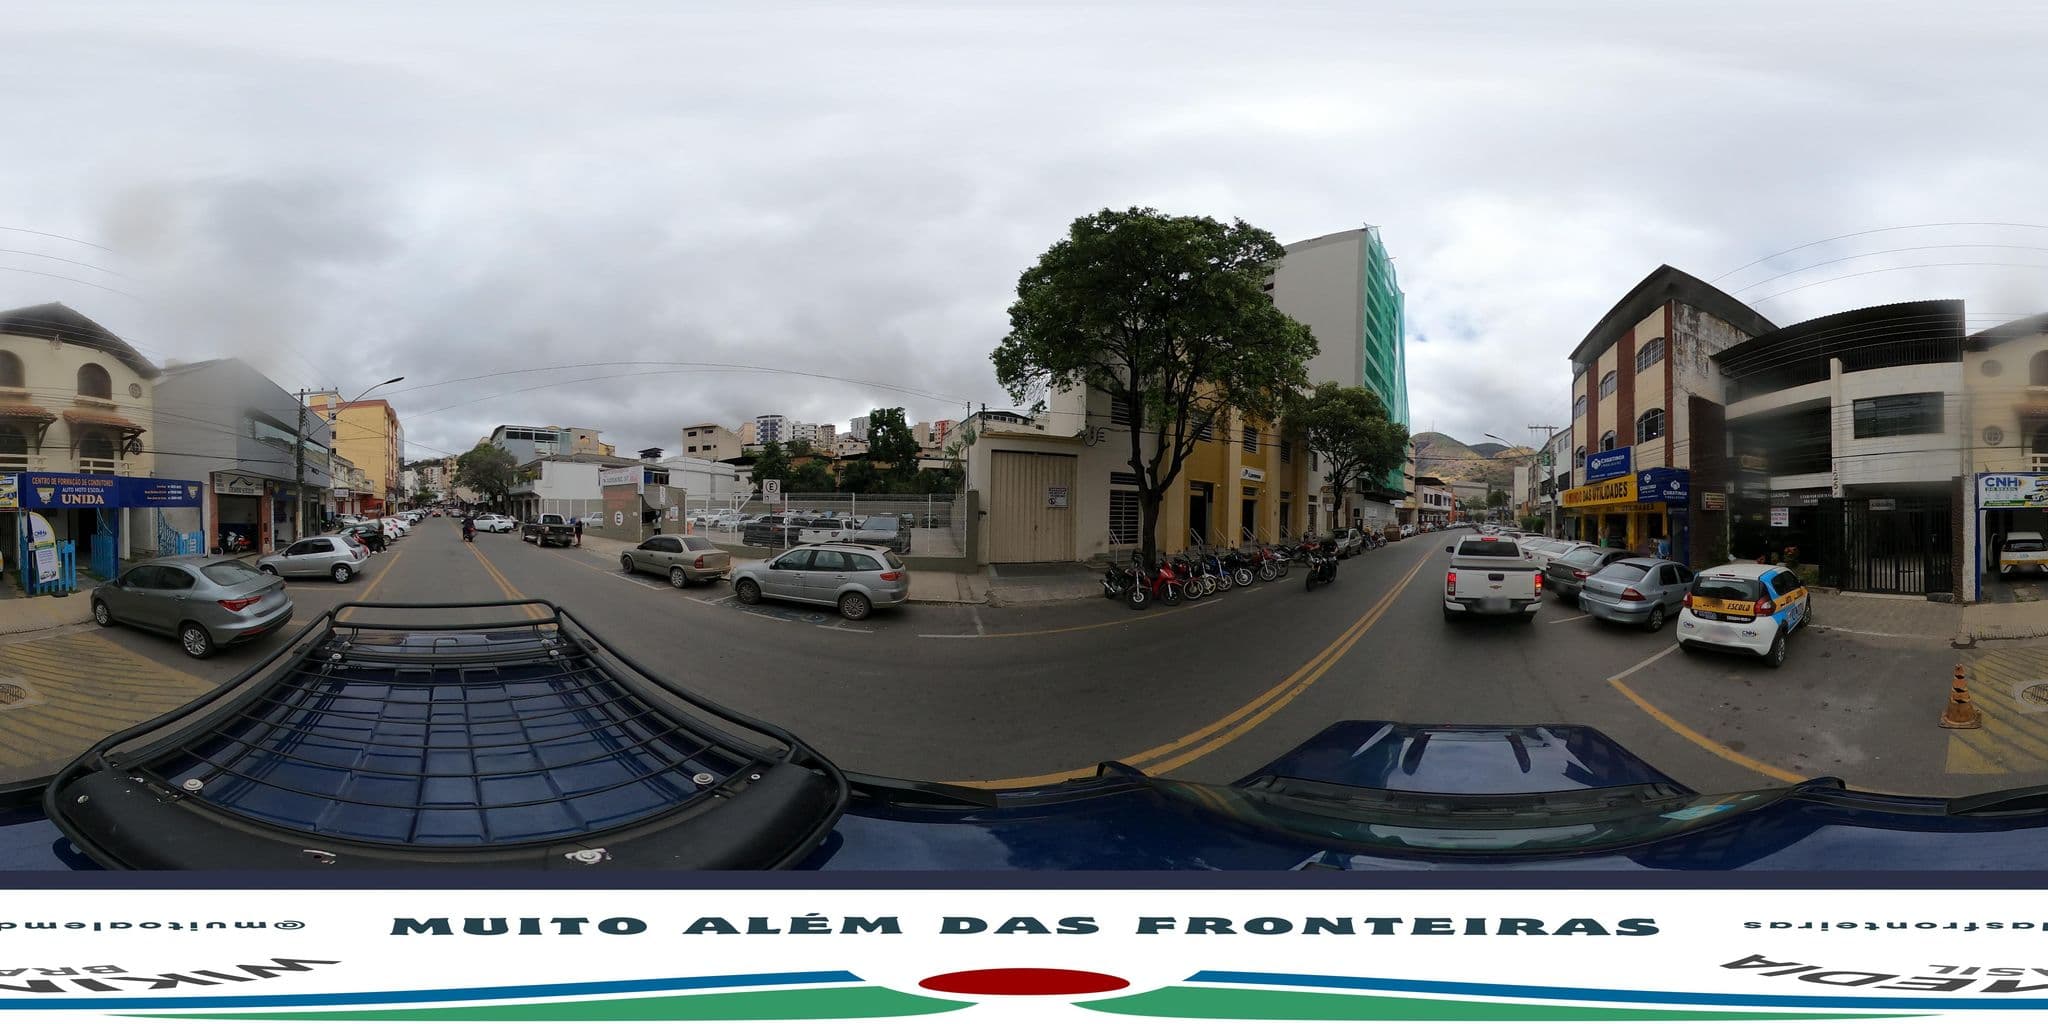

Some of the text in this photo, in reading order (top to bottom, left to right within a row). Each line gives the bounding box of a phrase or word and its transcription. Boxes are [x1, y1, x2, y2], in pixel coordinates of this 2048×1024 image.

[32, 477, 50, 485] CENTRO
[1985, 476, 2017, 487] CNH
[1592, 481, 1628, 502] UTILIDADES
[61, 494, 104, 505] UNIDA
[1727, 602, 1751, 612] ESCOLA
